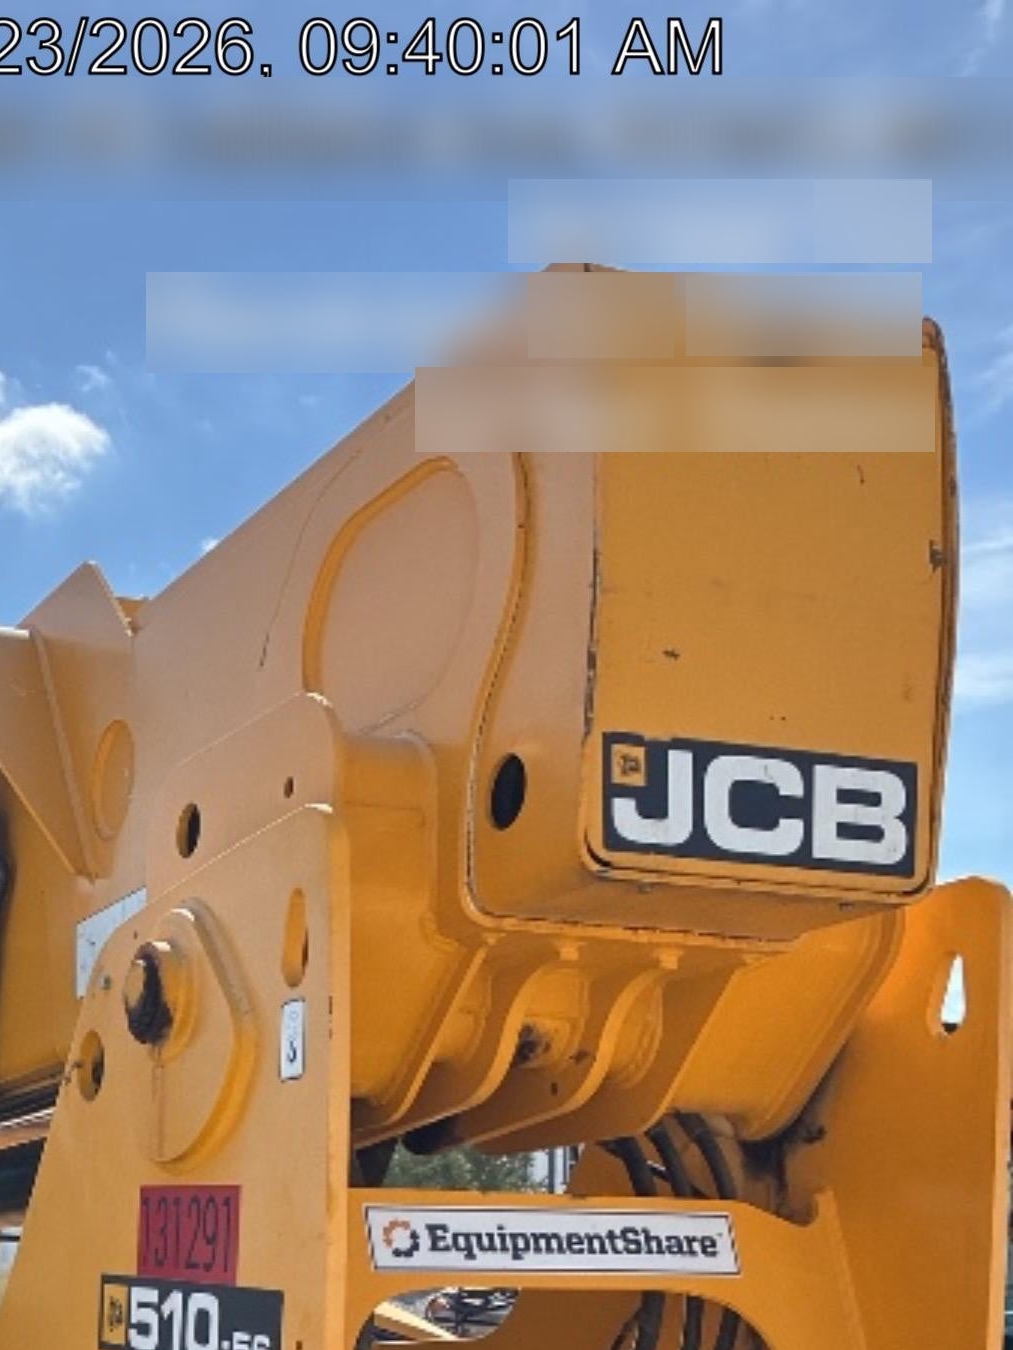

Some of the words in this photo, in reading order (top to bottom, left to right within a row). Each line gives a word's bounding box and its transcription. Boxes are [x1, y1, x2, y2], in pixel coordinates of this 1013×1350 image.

[610, 749, 908, 865] JCB
[141, 1194, 232, 1274] 131291
[425, 1223, 720, 1261] EquipmentShare
